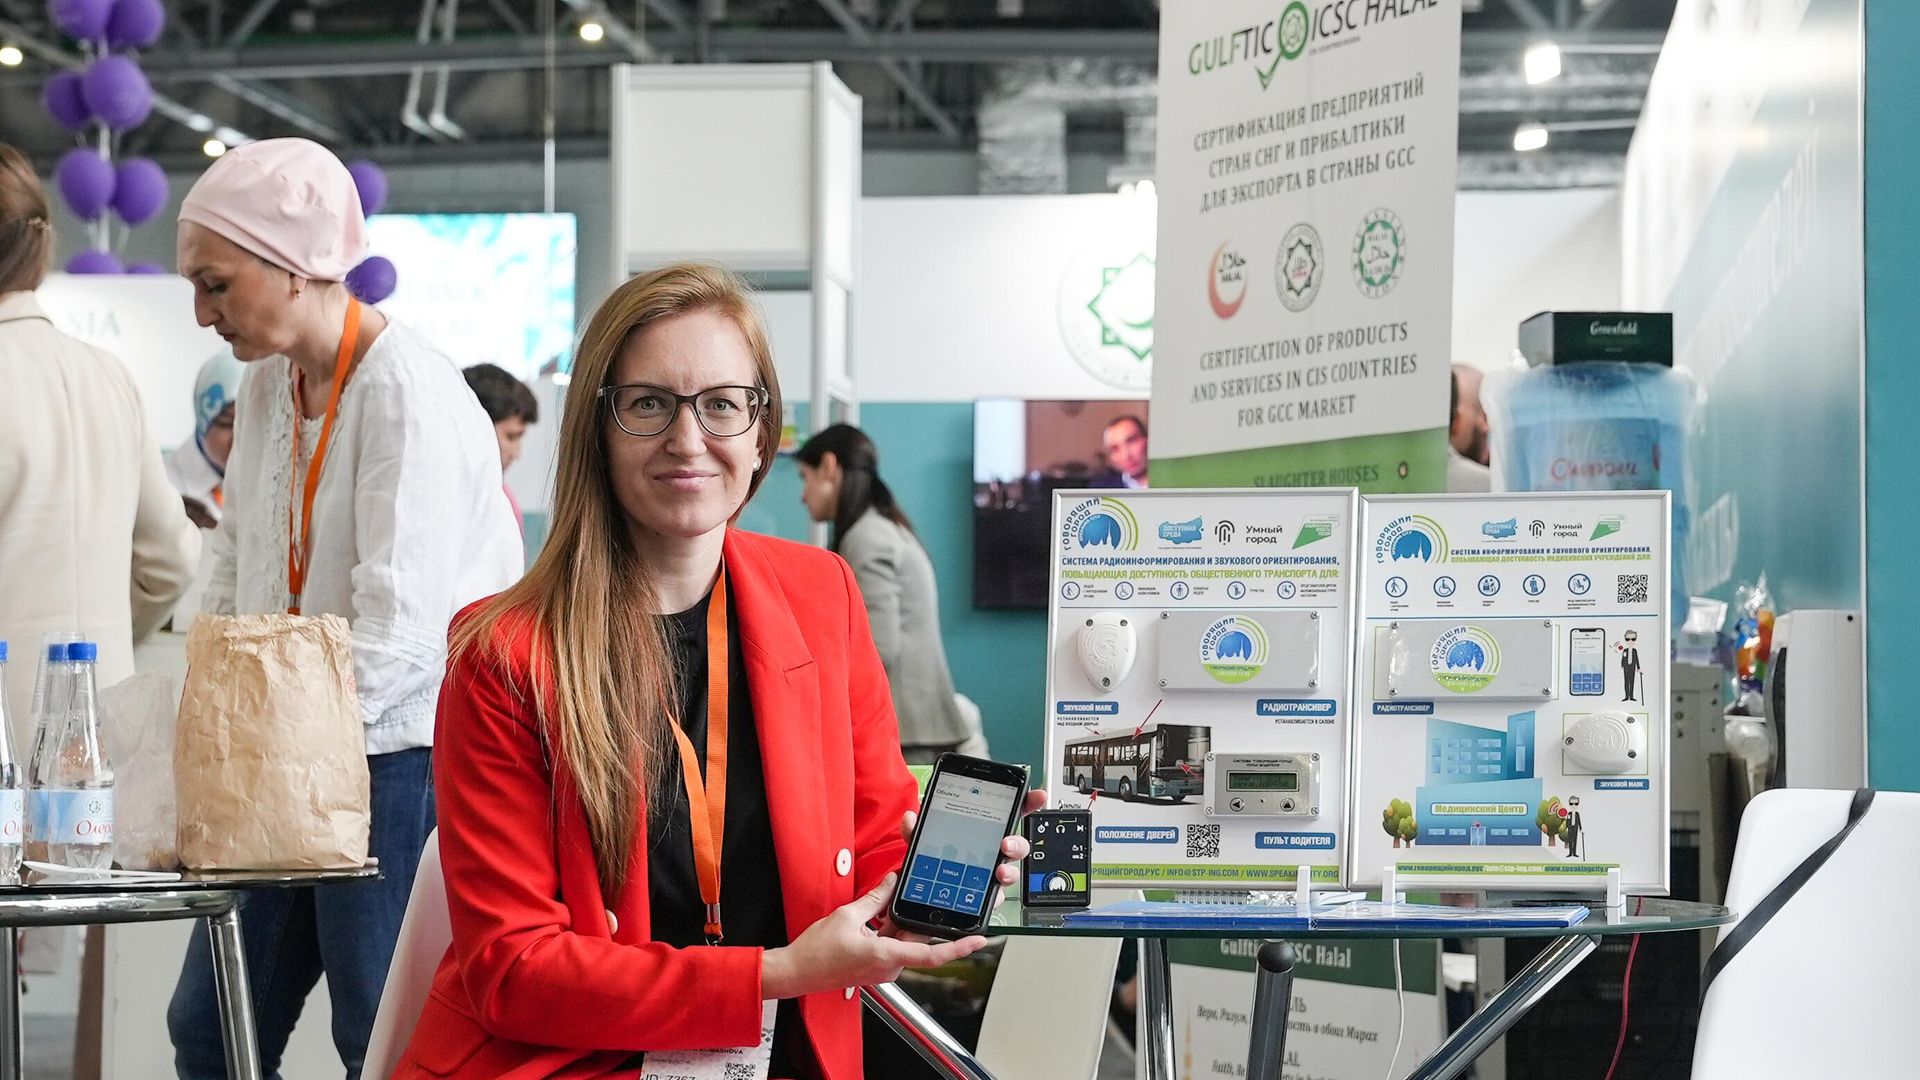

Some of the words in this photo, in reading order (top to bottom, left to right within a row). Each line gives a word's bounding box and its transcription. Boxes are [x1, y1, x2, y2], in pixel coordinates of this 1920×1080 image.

[1188, 21, 1274, 76] GULFTIC
[1364, 0, 1438, 26] HAL
[1193, 106, 1305, 152] СЕРТИФИКАЦИЯ
[1311, 72, 1425, 121] ПРЕДПРИЯТИЙ
[1209, 152, 1251, 179] СТРАН
[1254, 144, 1281, 168] СНГ
[1285, 141, 1296, 161] И
[1300, 115, 1406, 157] ПРИБАЛТИКИ
[1200, 187, 1228, 213] ДЛЯ
[1230, 172, 1302, 205] ЭКСПОРТА
[1306, 169, 1317, 187] В
[1320, 155, 1380, 184] СТРАНЫ
[1386, 146, 1416, 171] GCC
[1200, 338, 1301, 371] CERTIFICATION
[1305, 335, 1324, 354] OF
[1327, 322, 1408, 352] PRODUCTS
[1191, 382, 1217, 403] AND
[1220, 372, 1282, 398] SERVICES
[1286, 369, 1302, 388] IN
[1306, 365, 1327, 386] CIS
[1331, 354, 1418, 384] COUNTRIES
[1238, 406, 1264, 427] FOR
[1268, 403, 1294, 423] GCC
[1299, 395, 1356, 421] MARKET
[1329, 465, 1379, 484] HOUSES
[1063, 497, 1101, 551] ГОВОРЯЩИЙ
[1070, 509, 1092, 538] ГОРОД
[1246, 525, 1283, 534] Умный
[1246, 536, 1278, 544] город
[1383, 526, 1403, 552] ГОРОД
[1062, 557, 1098, 566] СИСТЕМА
[1099, 557, 1206, 567] РАДИОИНФОРМИРОВАНИЯ
[1206, 557, 1213, 565] И
[1214, 556, 1261, 565] ЗВУКОВОГО
[1263, 556, 1340, 566] ОРИЕНТИРОВАНИЯ,
[1129, 570, 1189, 579] ДОСТУПНОСТЬ
[1190, 570, 1262, 579] ОБЩЕСТВЕННОГО
[1264, 569, 1318, 578] ТРАНСПОРТА
[1063, 703, 1095, 712] ЗВУКОВОЙ
[1095, 704, 1113, 712] МАЯК
[1263, 703, 1332, 712] РАДИОТРАНСИВЕР
[1435, 804, 1497, 813] Медицинский
[1498, 804, 1524, 815] Центр
[1099, 830, 1145, 840] ПОЛОЖЕНИЕ
[1146, 828, 1176, 840] ДВЕРЕЙ
[1263, 836, 1289, 846] ПУЛЬТ
[1290, 836, 1331, 846] ВОДИТЕЛЯ
[1089, 867, 1160, 877] РЯЩИЙГОРОД.РУС
[1315, 944, 1352, 968] Halal
